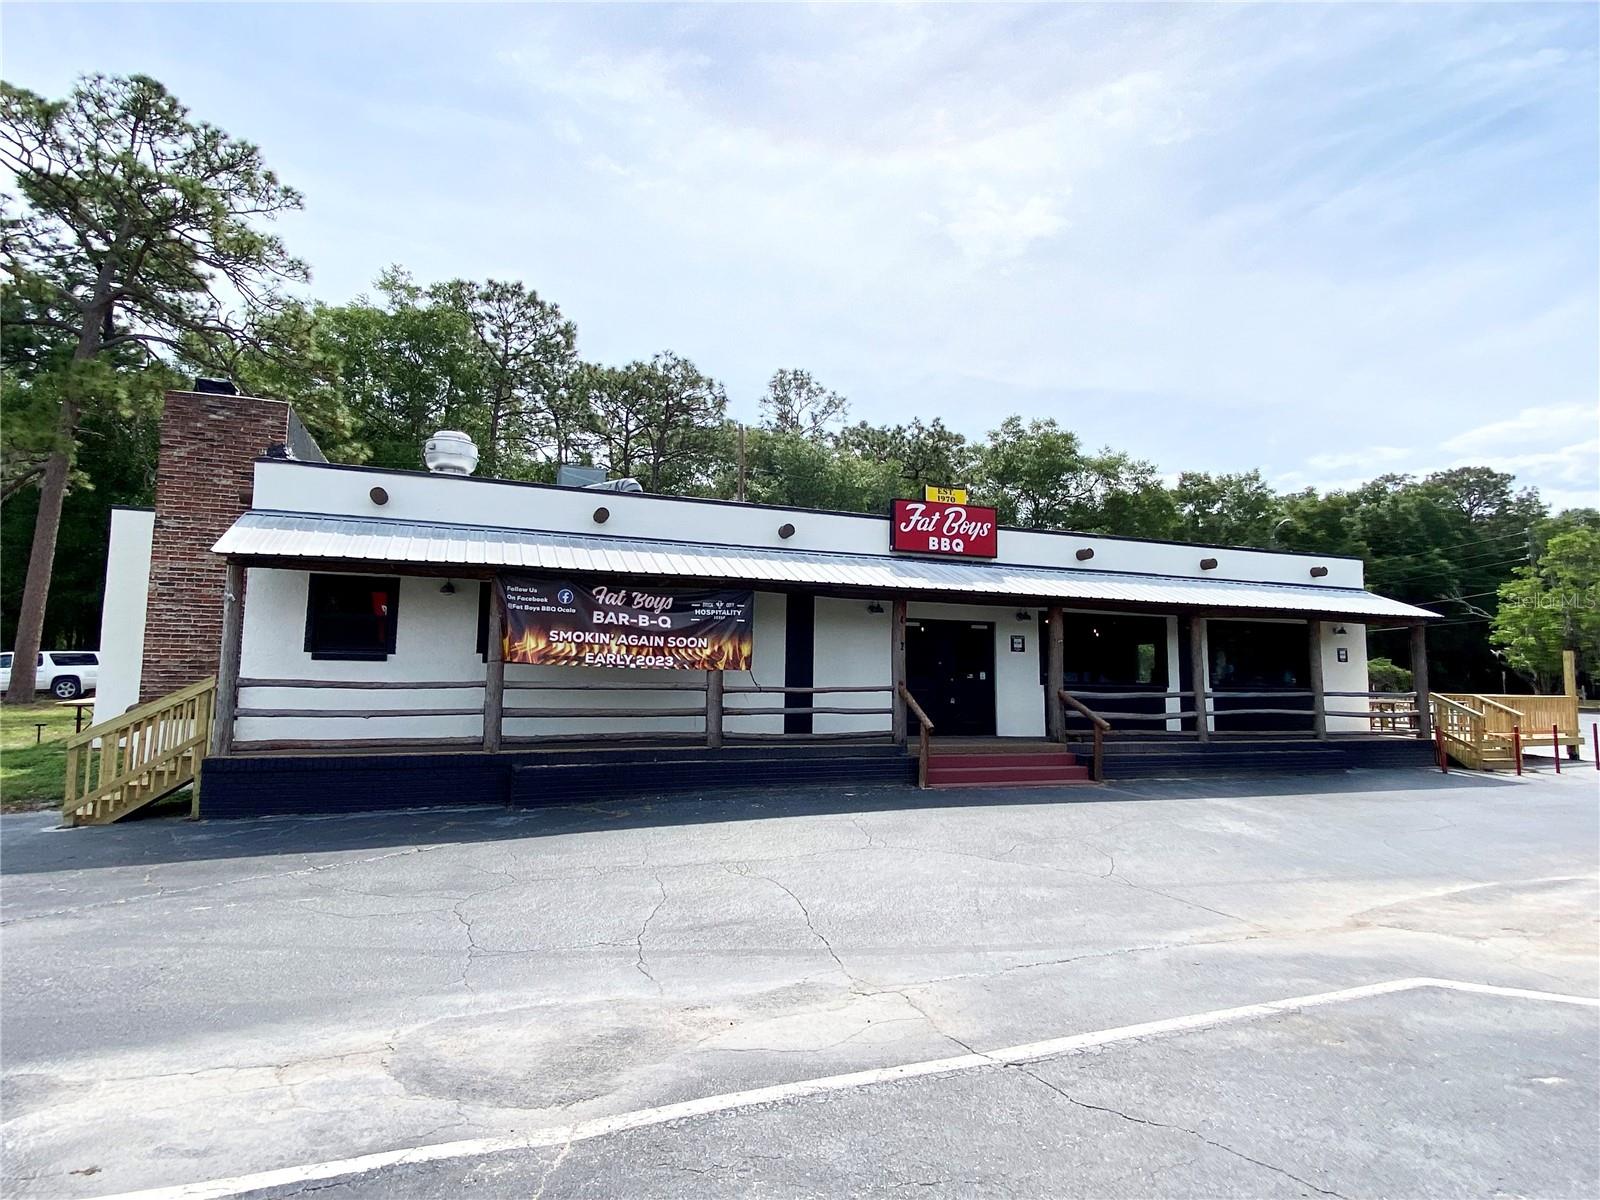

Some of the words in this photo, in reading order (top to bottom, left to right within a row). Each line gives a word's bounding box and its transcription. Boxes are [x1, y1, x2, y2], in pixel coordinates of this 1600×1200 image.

[937, 495, 956, 503] 1970
[900, 503, 940, 532] Fat
[942, 506, 992, 541] Boys
[928, 536, 964, 552] BBQ
[506, 585, 528, 593] Follow
[516, 595, 548, 603] Facebook
[592, 586, 627, 606] Fat
[631, 591, 674, 615] Boys
[524, 604, 540, 612] Boys
[557, 606, 577, 614] Ocala
[592, 610, 672, 629] BAR-B-Q
[549, 630, 615, 644] SMOKIN'
[616, 634, 664, 647] AGAIN
[667, 636, 708, 648] SOON
[585, 653, 635, 666] EARLY
[636, 655, 674, 667] 2023
